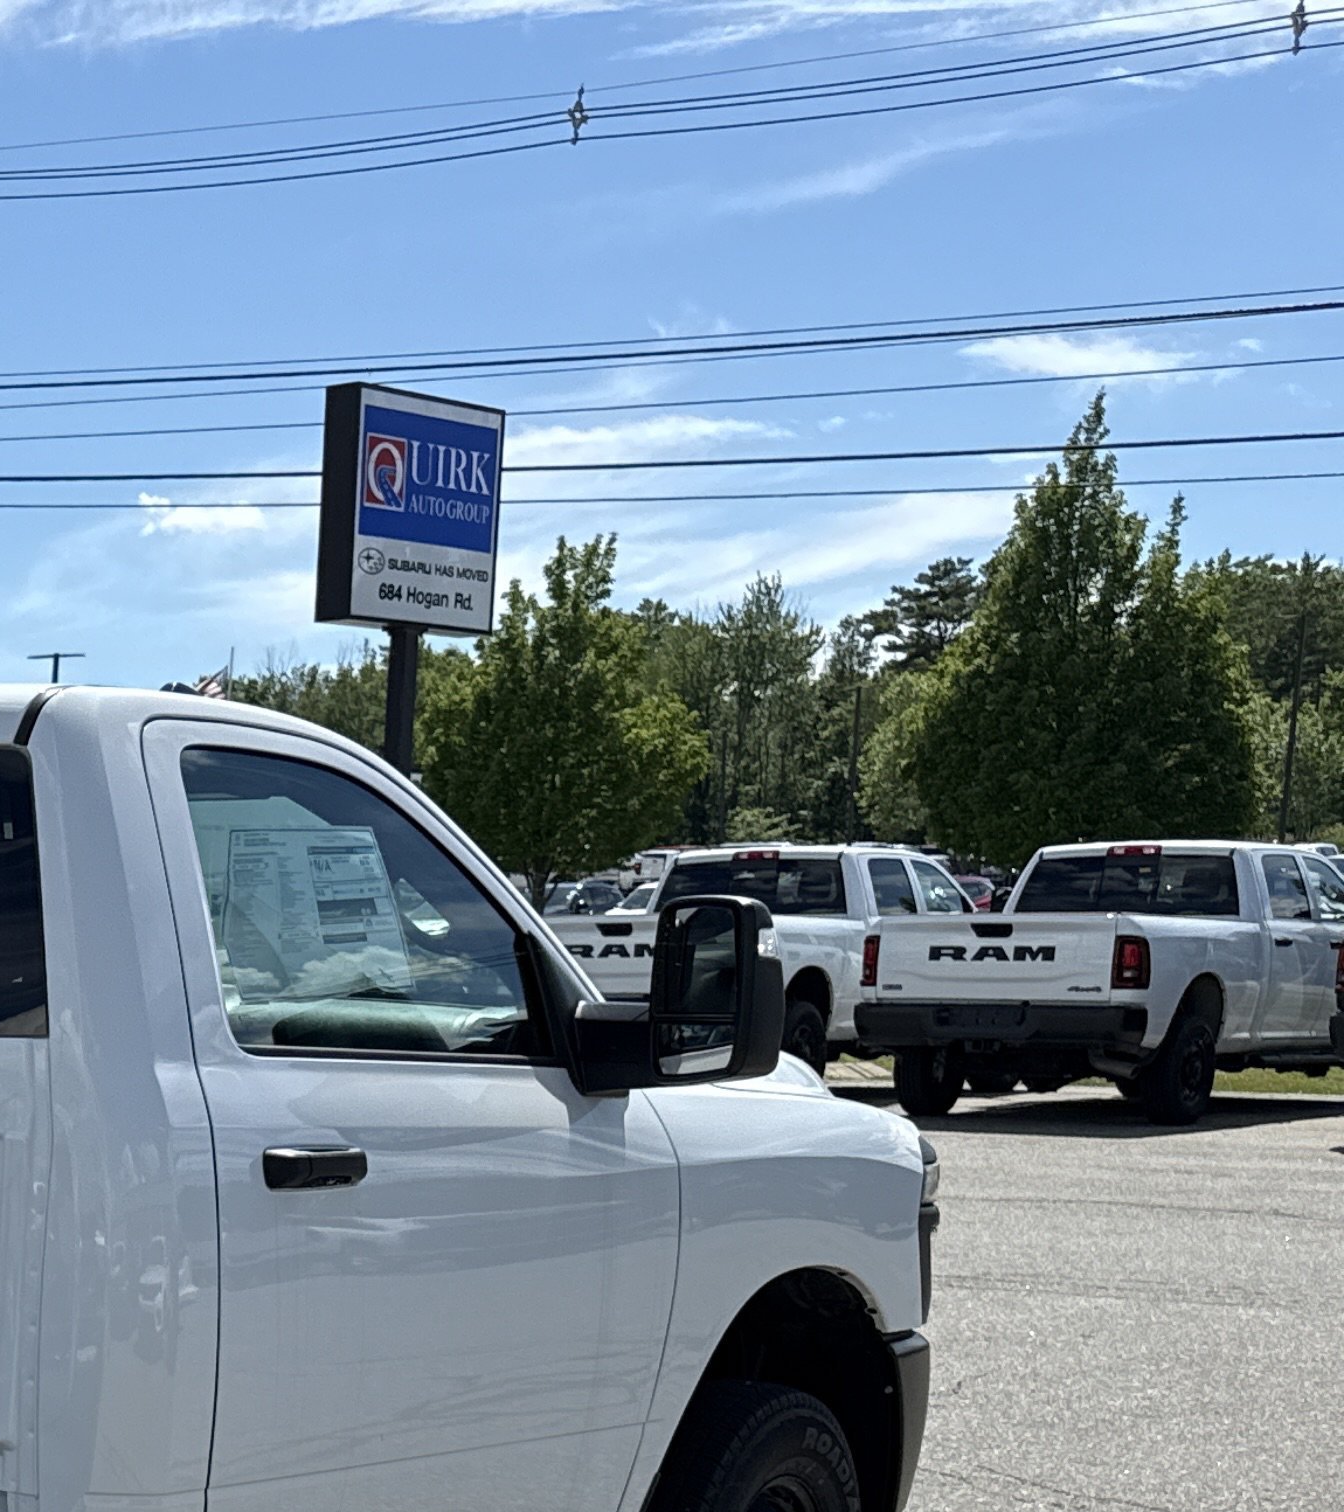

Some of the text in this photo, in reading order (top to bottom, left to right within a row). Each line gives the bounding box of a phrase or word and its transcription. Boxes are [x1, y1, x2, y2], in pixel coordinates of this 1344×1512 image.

[368, 440, 491, 504] QUIRK
[388, 558, 489, 582] SUBARU HAS MOVED
[379, 582, 474, 611] 684 Hogan Rd.
[928, 945, 1056, 961] RAM
